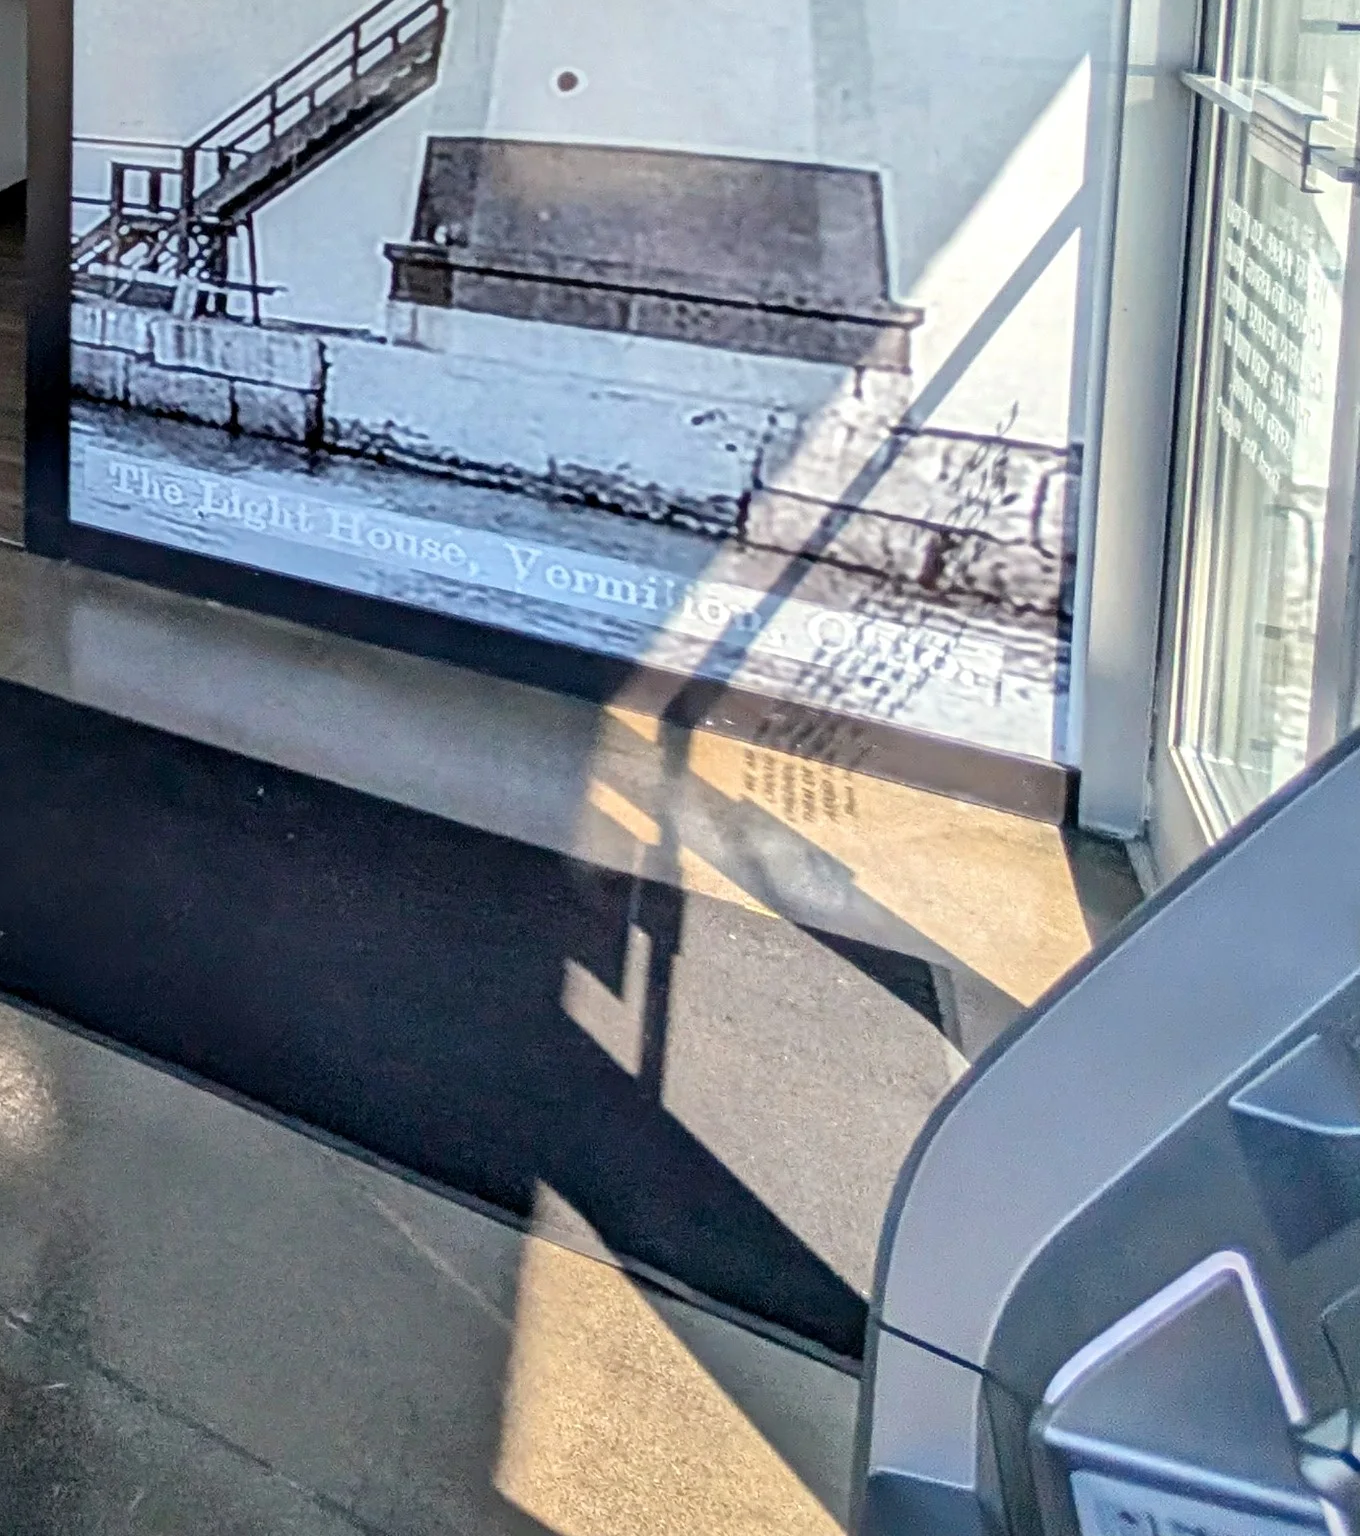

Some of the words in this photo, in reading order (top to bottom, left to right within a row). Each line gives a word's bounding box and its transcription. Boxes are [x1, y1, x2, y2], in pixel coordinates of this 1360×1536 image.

[108, 463, 184, 505] The
[194, 478, 314, 532] Light
[325, 505, 478, 577] House,
[504, 542, 787, 646] Vermilion,
